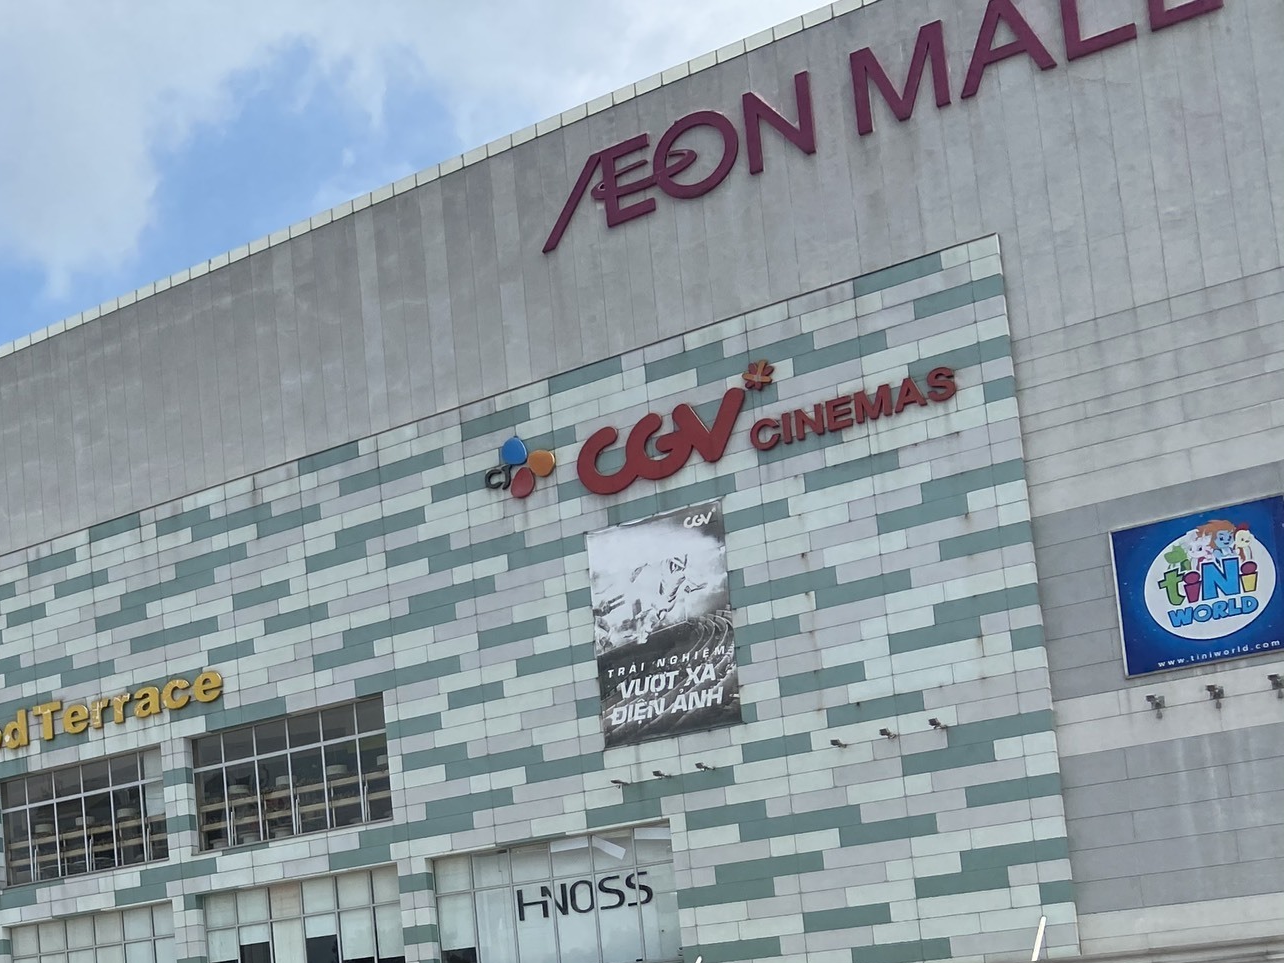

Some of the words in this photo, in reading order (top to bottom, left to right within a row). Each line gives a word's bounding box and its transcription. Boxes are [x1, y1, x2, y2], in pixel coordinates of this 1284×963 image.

[577, 387, 745, 495] CGV
[750, 366, 957, 451] CINEMAS
[683, 510, 713, 529] CGV
[1167, 595, 1259, 628] WORLD
[1157, 638, 1281, 668] www.tiniworld.com
[617, 669, 680, 700] VƯỢT
[684, 662, 717, 687] XA
[610, 696, 667, 725] ĐIỆN
[670, 686, 725, 715] ẢNH
